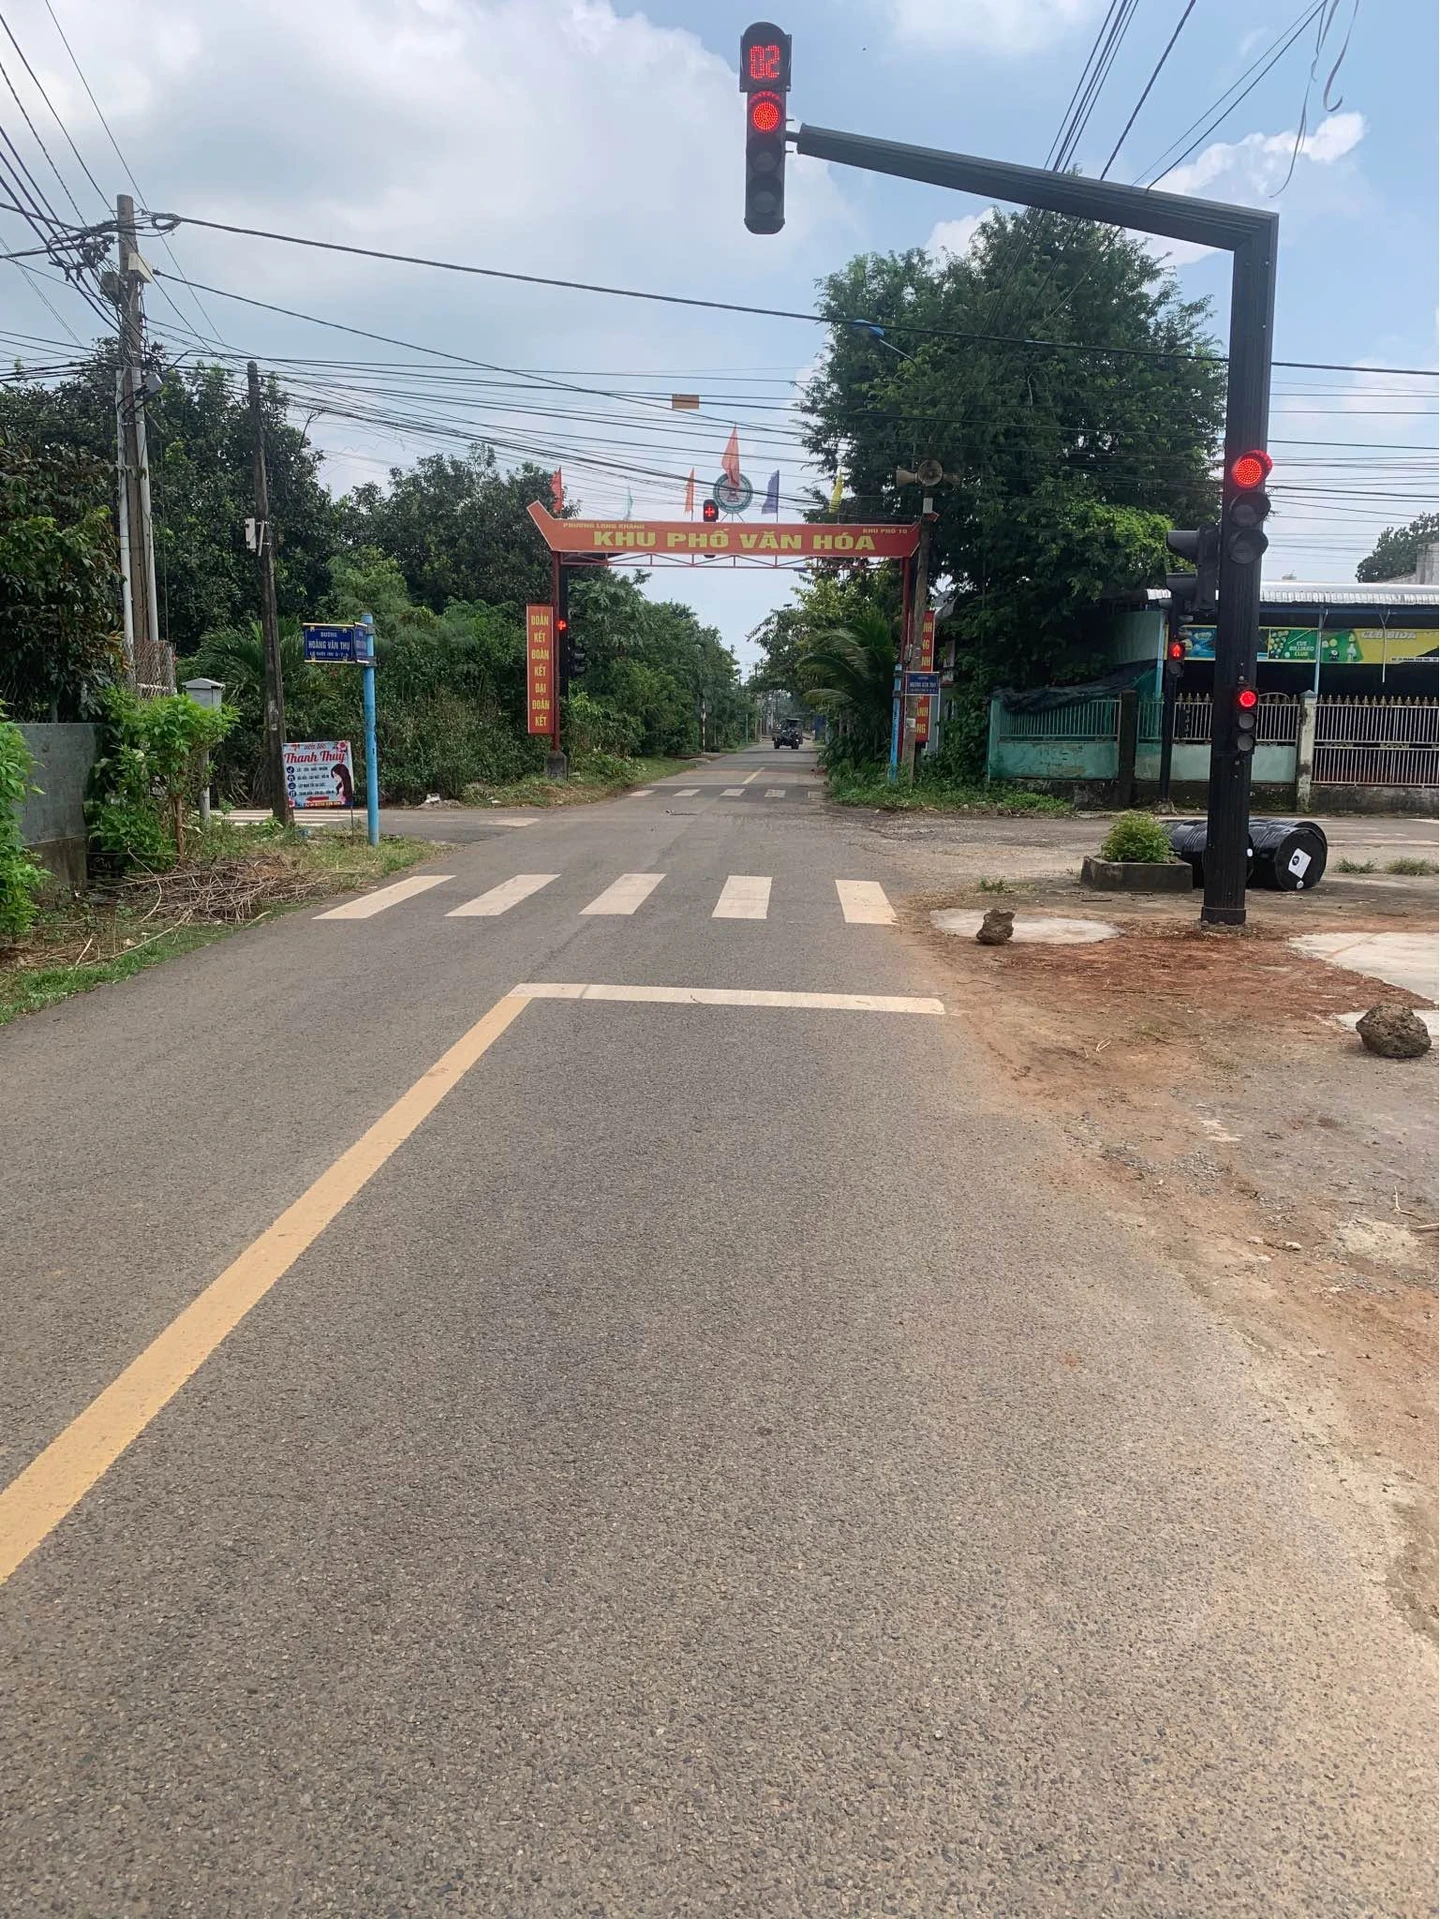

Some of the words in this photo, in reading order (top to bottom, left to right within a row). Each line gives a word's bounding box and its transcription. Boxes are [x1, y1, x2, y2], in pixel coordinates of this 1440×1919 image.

[750, 45, 780, 79] 02
[593, 531, 657, 547] KHU
[666, 528, 729, 549] PHỐ
[739, 530, 802, 550] VĂN
[813, 531, 876, 550] HÓA
[531, 612, 549, 627] ĐOÀN
[533, 630, 546, 643] KẾT
[1387, 631, 1416, 639] BIDA
[308, 639, 327, 649] HOÀNG
[327, 640, 339, 650] VĂN
[531, 647, 550, 660] ĐOÀN
[534, 664, 546, 677] KẾT
[535, 683, 547, 696] ĐẠI
[531, 698, 550, 710] ĐOÀN
[535, 713, 547, 727] KẾT
[284, 752, 318, 763] Thanh
